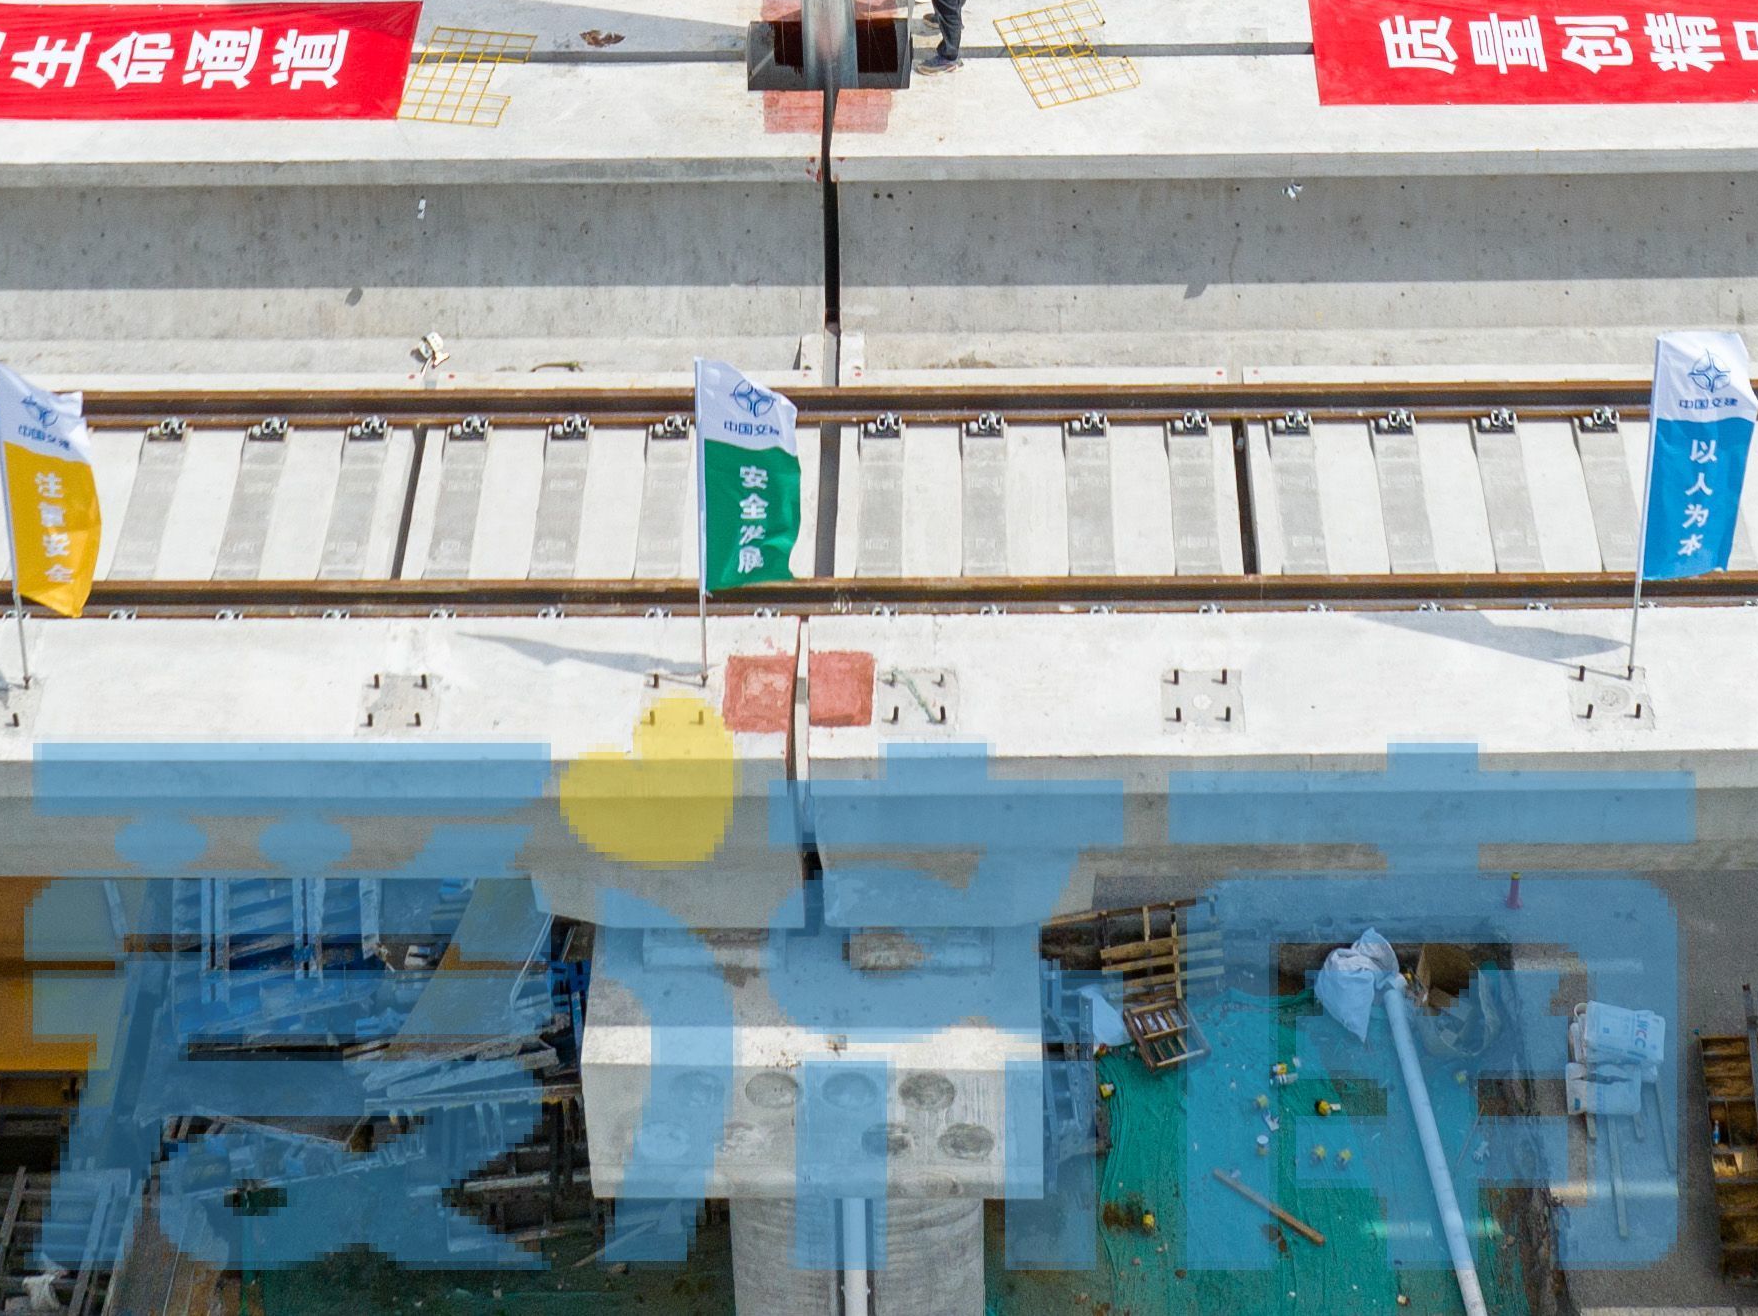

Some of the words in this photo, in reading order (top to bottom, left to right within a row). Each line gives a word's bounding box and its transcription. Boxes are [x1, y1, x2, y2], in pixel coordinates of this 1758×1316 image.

[1678, 397, 1739, 410] 中国交建
[34, 471, 74, 584] 注重安全
[737, 464, 769, 575] 安全发展
[1677, 438, 1718, 557] 以人为本
